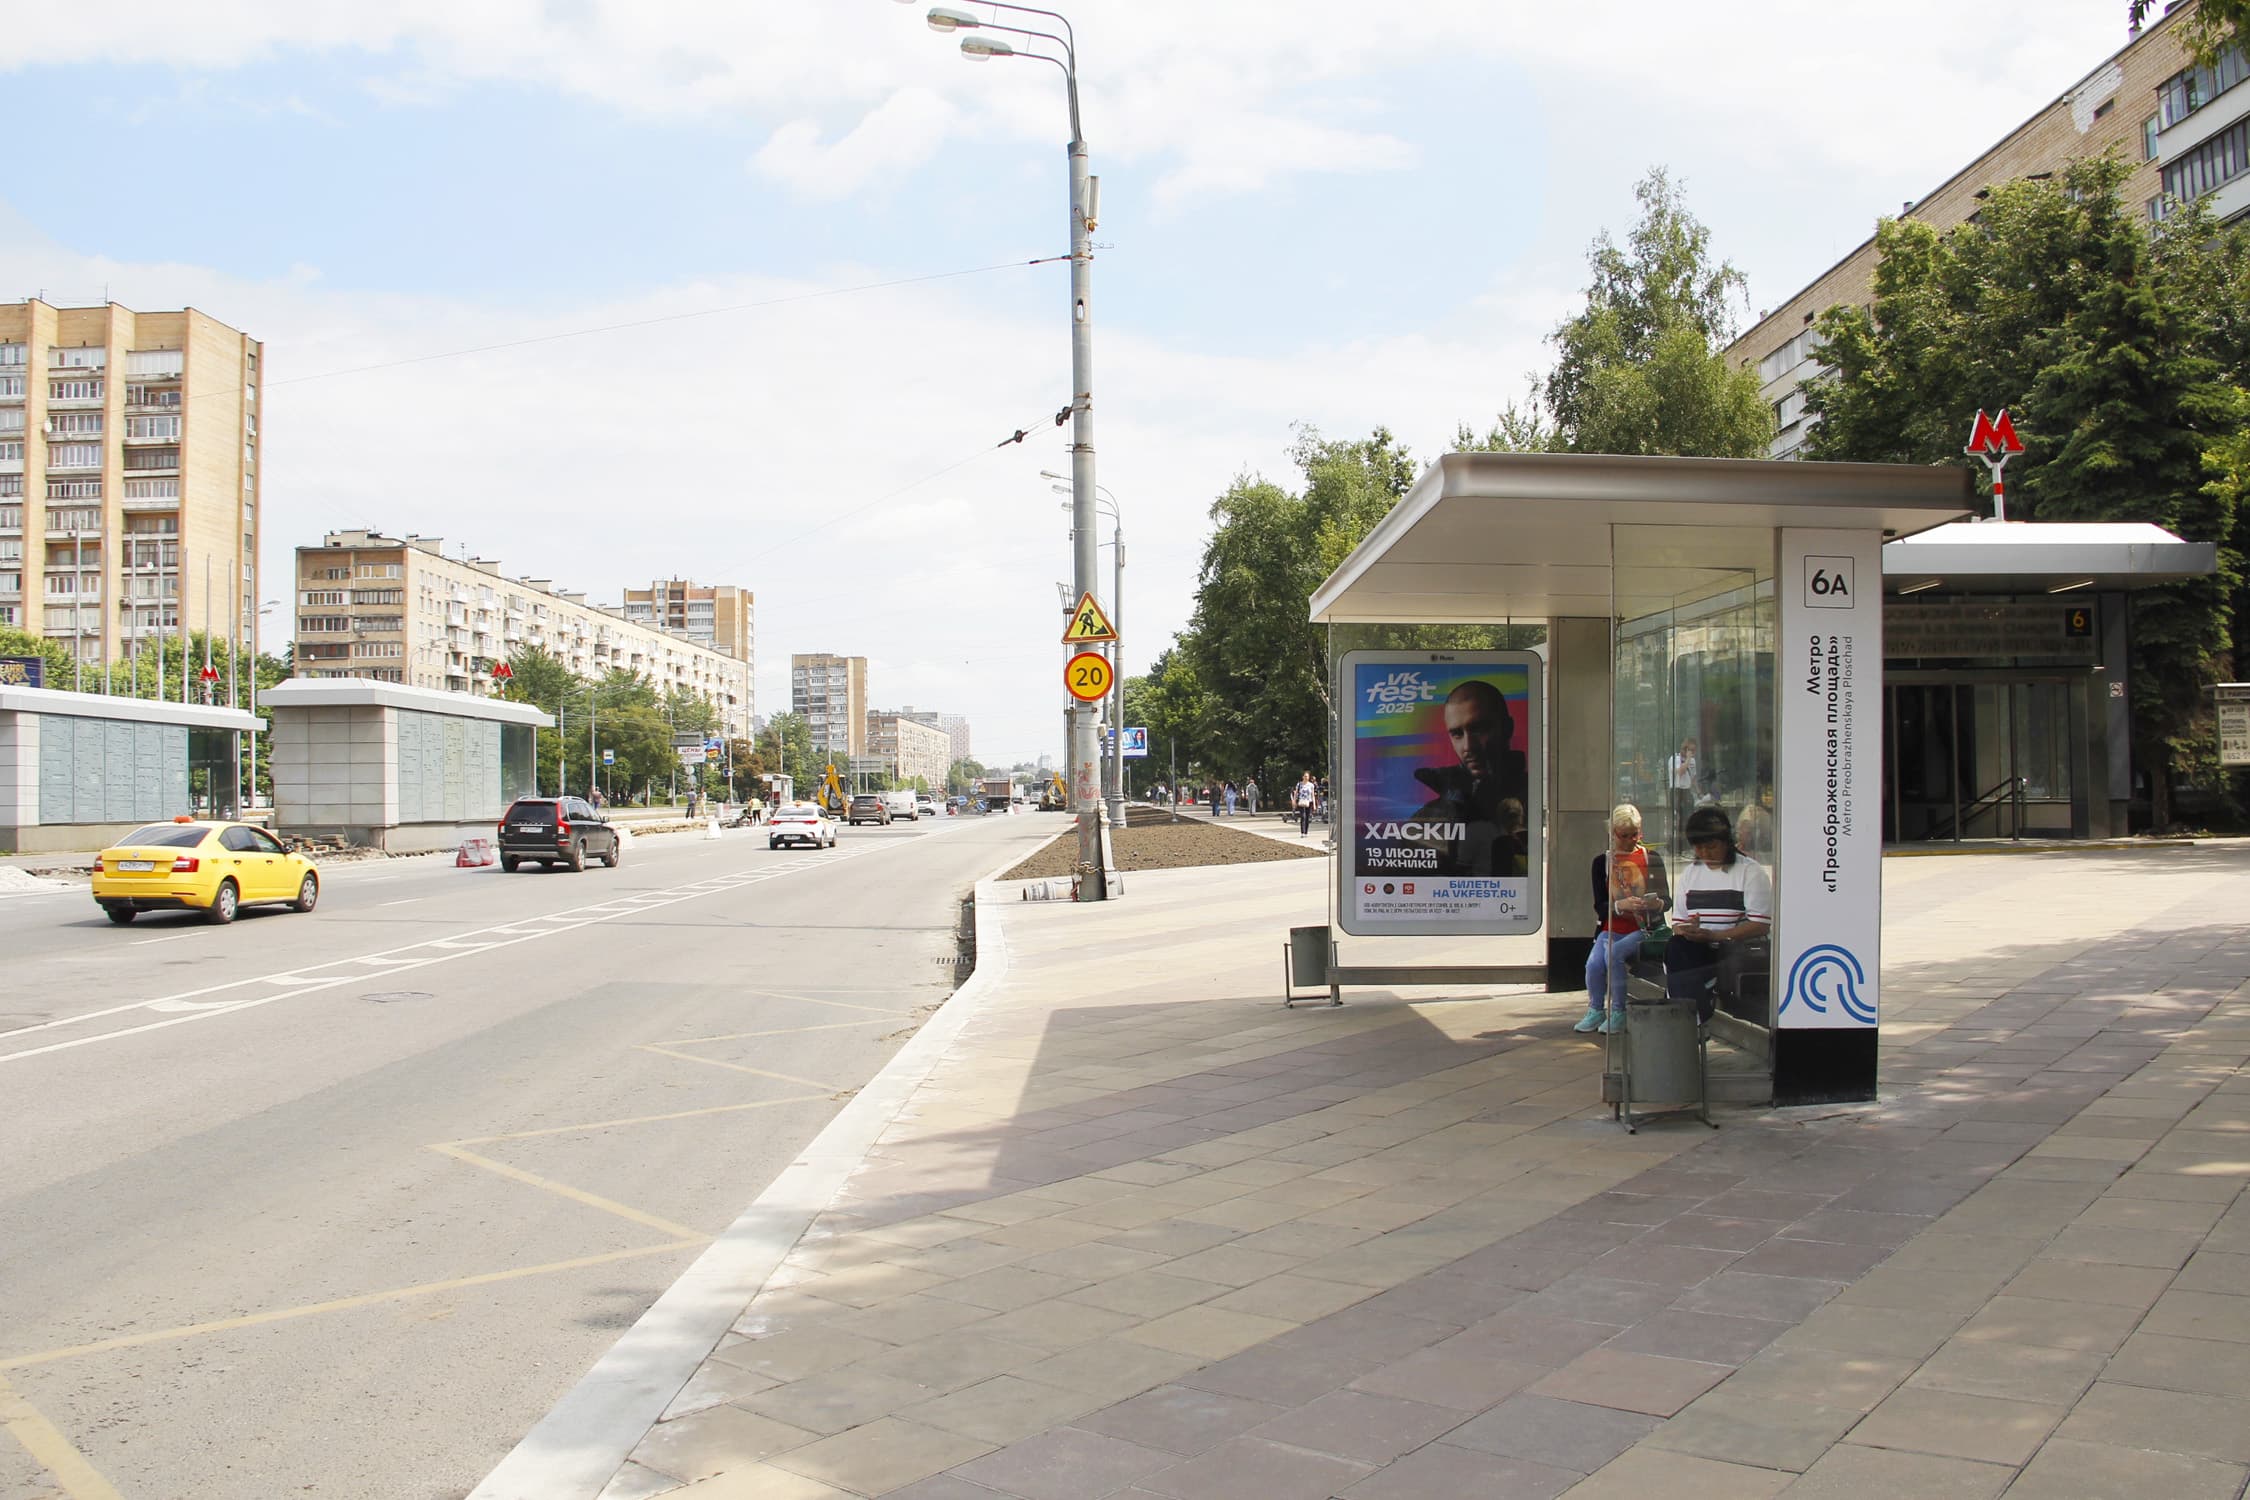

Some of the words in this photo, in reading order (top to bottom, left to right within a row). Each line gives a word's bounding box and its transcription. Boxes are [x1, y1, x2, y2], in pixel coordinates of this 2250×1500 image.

[1964, 408, 2026, 454] М
[1811, 568, 1849, 596] 6А
[2072, 610, 2085, 628] 6
[1806, 635, 1824, 696] Метро
[1842, 636, 1853, 688] Ploschad
[1076, 667, 1103, 686] 20
[1388, 672, 1421, 686] VK
[1826, 636, 1840, 724] площадь»
[1366, 680, 1437, 703] fest
[1375, 702, 1415, 714] 2025
[1841, 691, 1855, 797] Preobrazhenskaya
[1823, 728, 1841, 893] «Преображенская
[1841, 800, 1853, 837] Metro
[1364, 822, 1466, 841] ХАСКИ
[1365, 847, 1382, 858] 19
[1385, 848, 1437, 859] ИЮЛЯ
[1367, 858, 1438, 869] ЛУЖНИКИ
[1432, 889, 1450, 898] НА
[1452, 889, 1517, 898] VKFEST.RU
[1449, 880, 1501, 889] БИЛЕТЫ
[1500, 902, 1516, 914] 0+
